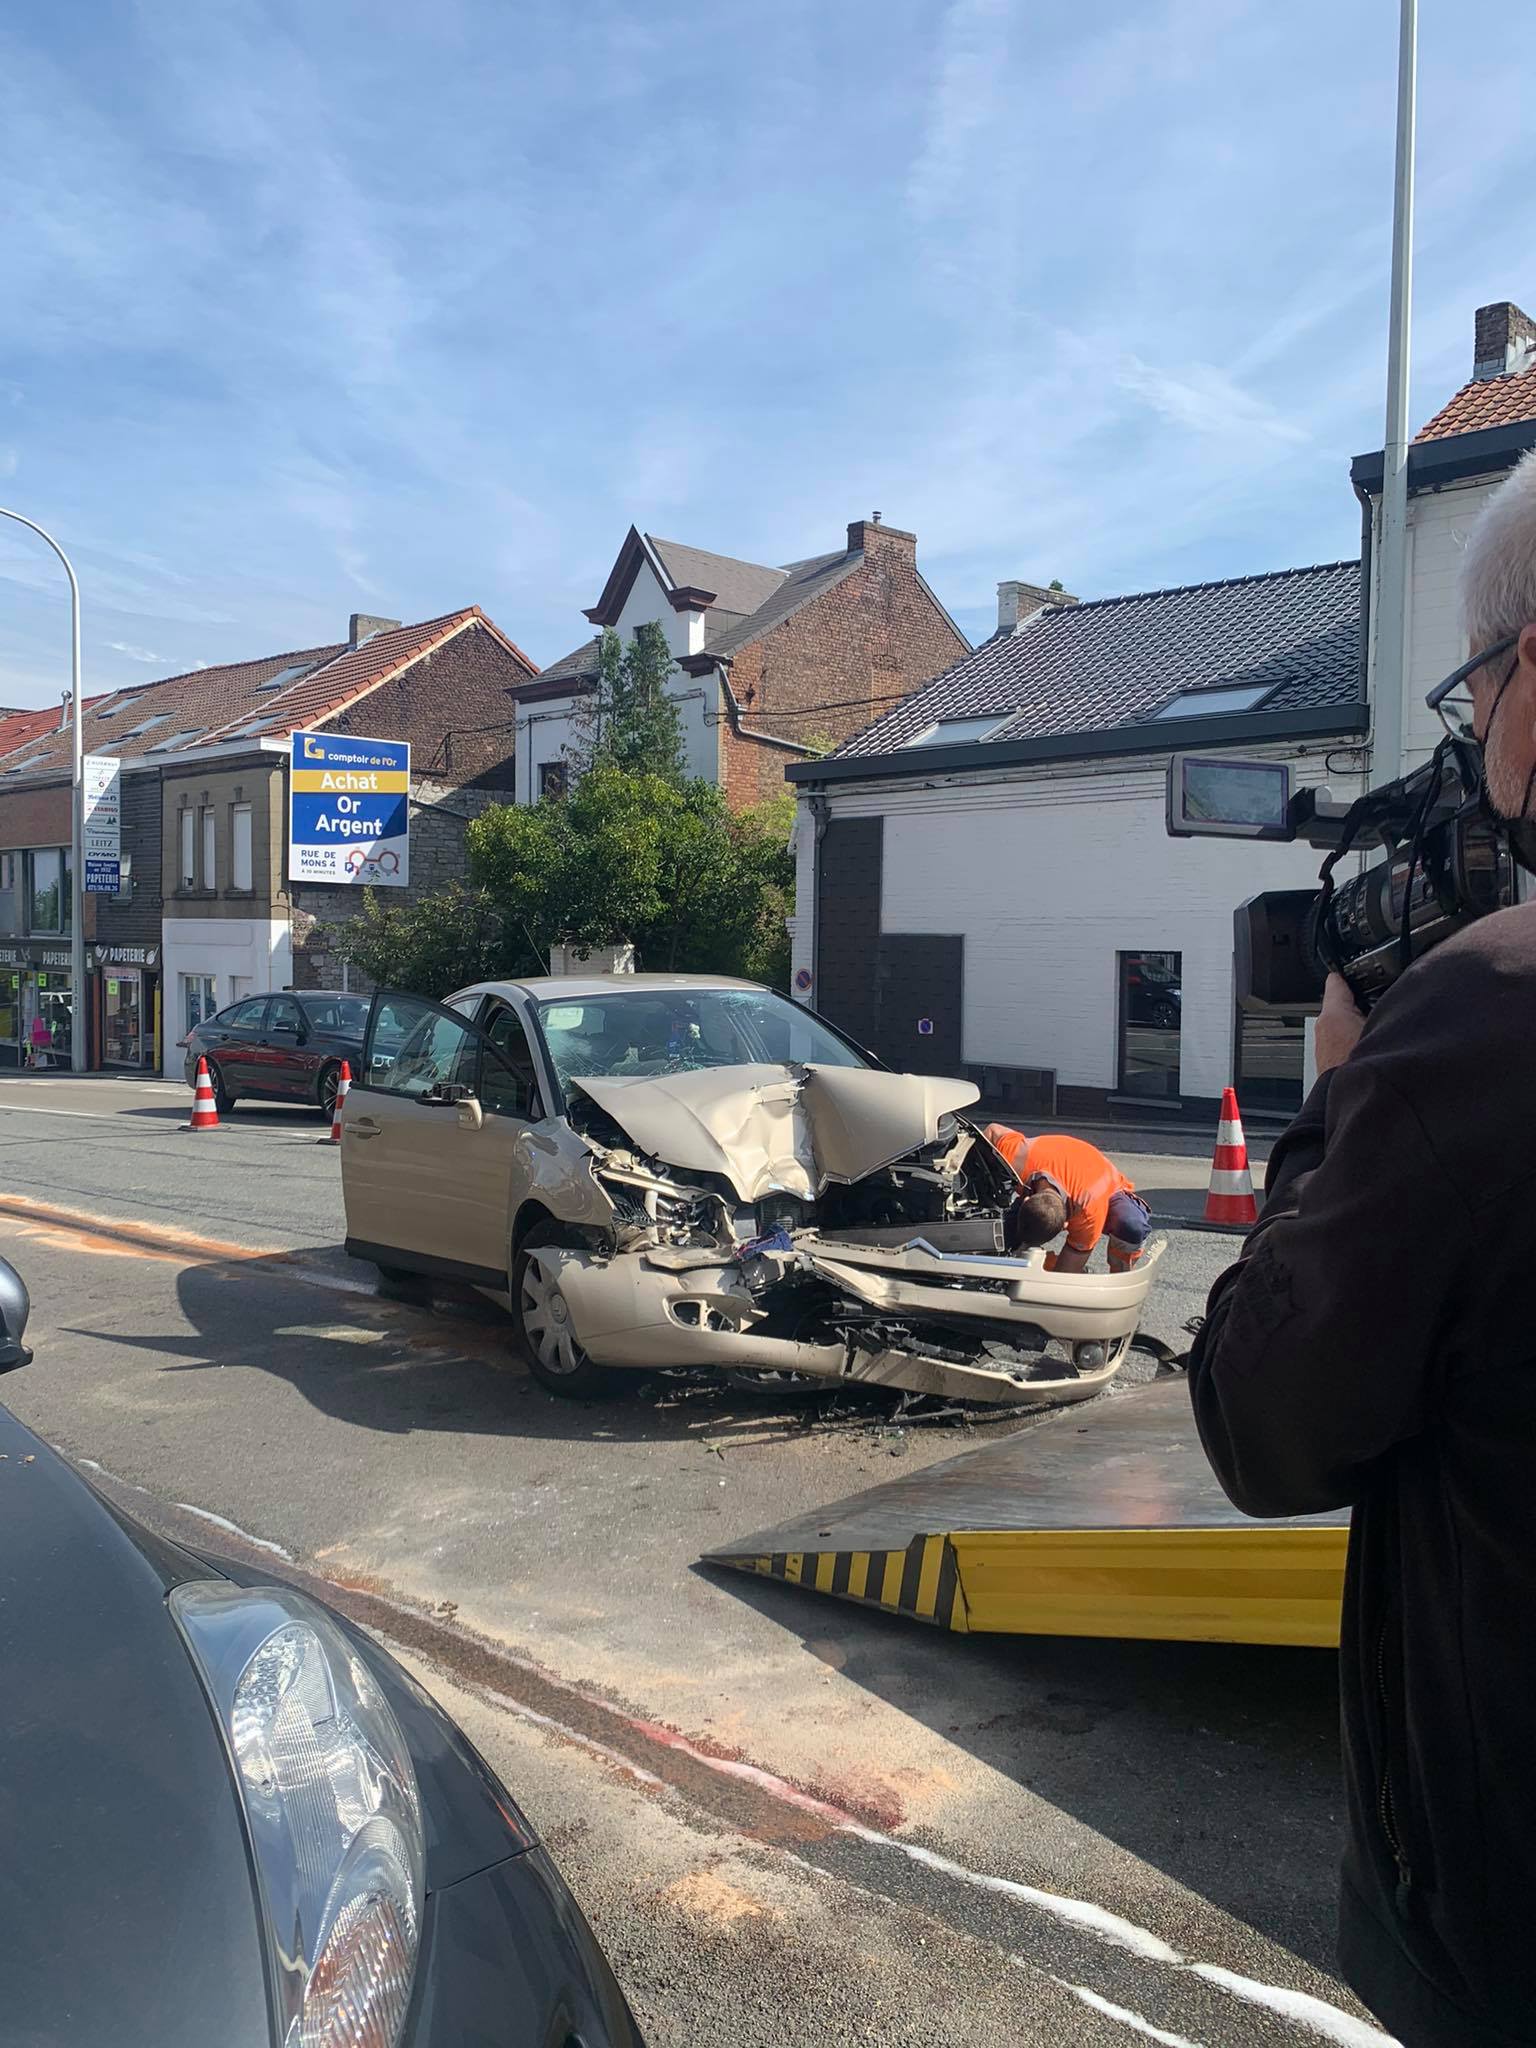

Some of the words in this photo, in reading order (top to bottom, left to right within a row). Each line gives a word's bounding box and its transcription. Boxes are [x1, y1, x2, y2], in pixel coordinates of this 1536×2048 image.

[328, 753, 369, 764] comptoir
[370, 756, 381, 765] de
[320, 772, 378, 789] Achat
[337, 795, 361, 814] Or
[315, 814, 383, 837] Argent
[91, 839, 112, 847] LEITZ
[301, 849, 319, 857] RUE
[324, 851, 336, 859] DE
[301, 859, 327, 867] MONS
[87, 873, 118, 883] PAPETERIE
[110, 947, 145, 962] PAPETERIE
